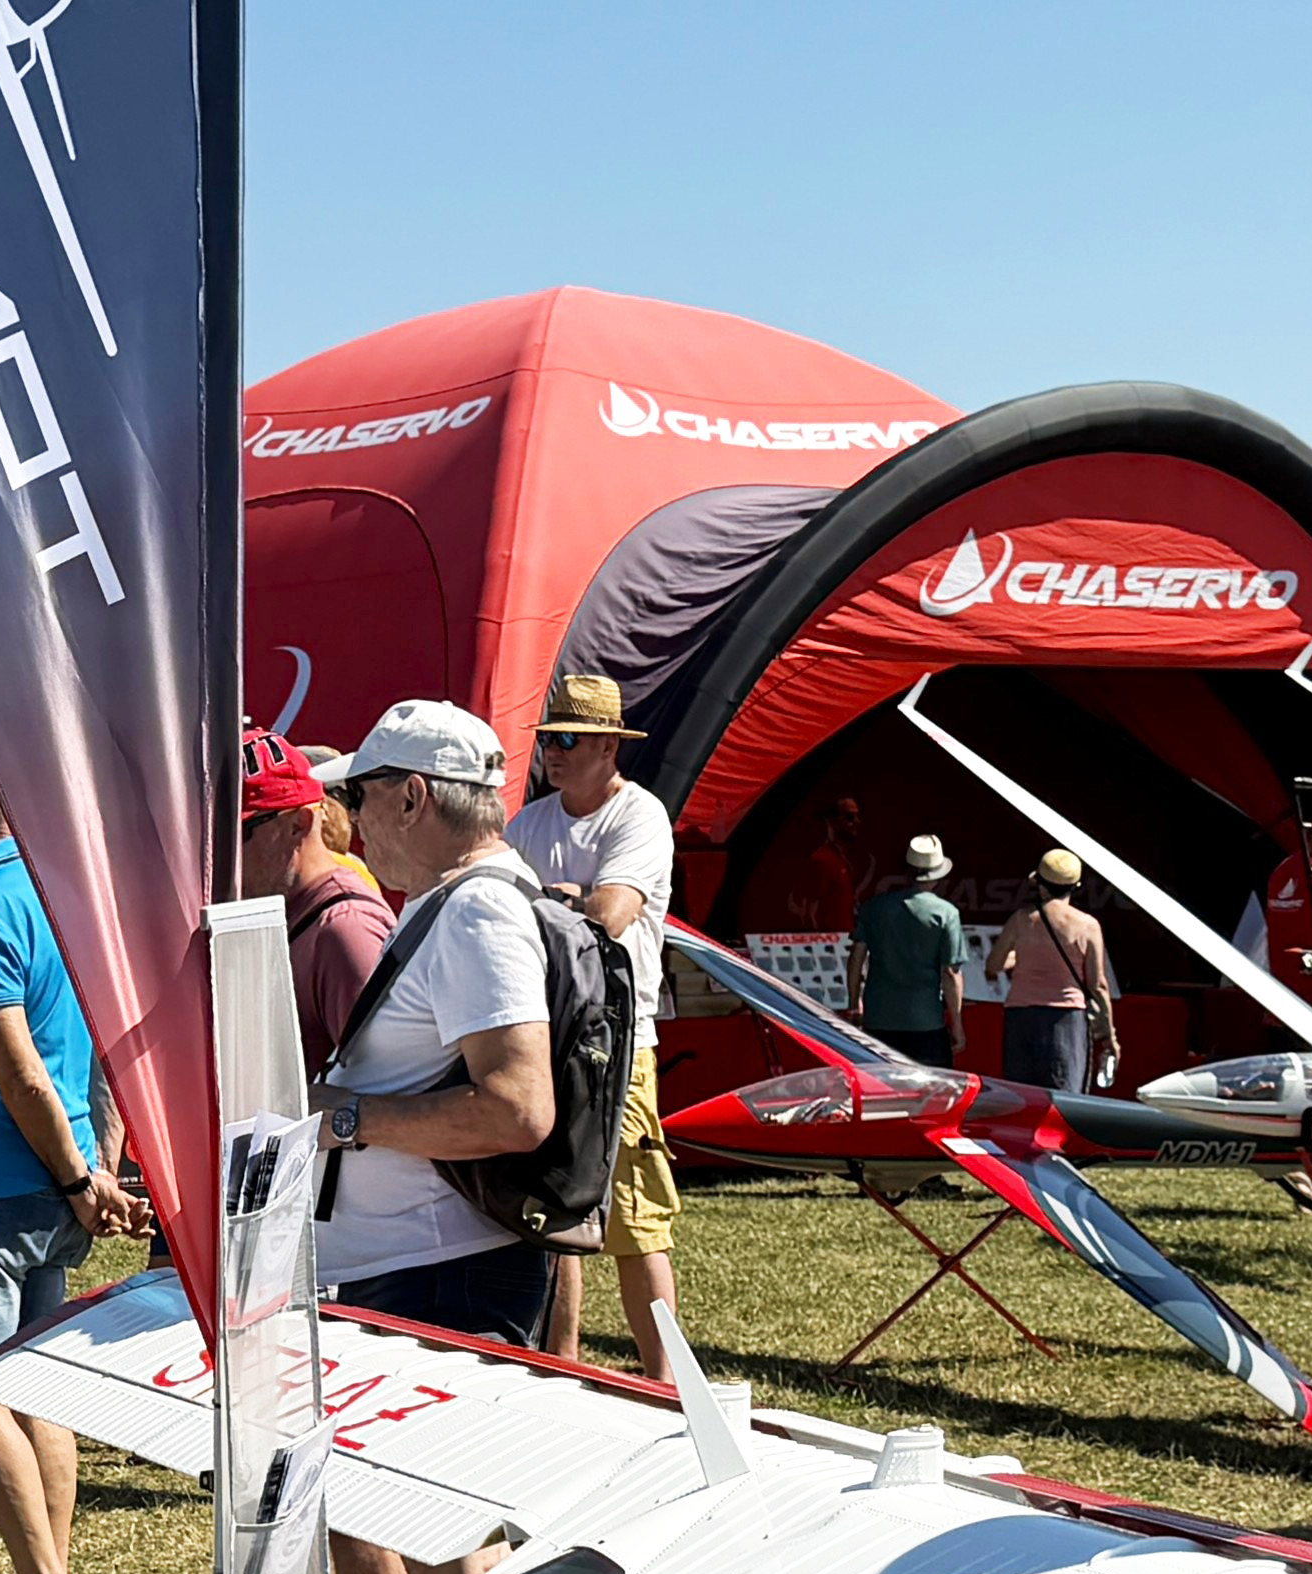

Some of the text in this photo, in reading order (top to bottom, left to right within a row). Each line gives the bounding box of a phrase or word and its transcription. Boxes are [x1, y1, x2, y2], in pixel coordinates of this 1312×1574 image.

[251, 396, 492, 458] CHASERVO
[1005, 561, 1299, 610] CHASERVO
[1153, 1140, 1258, 1165] MDM-1
